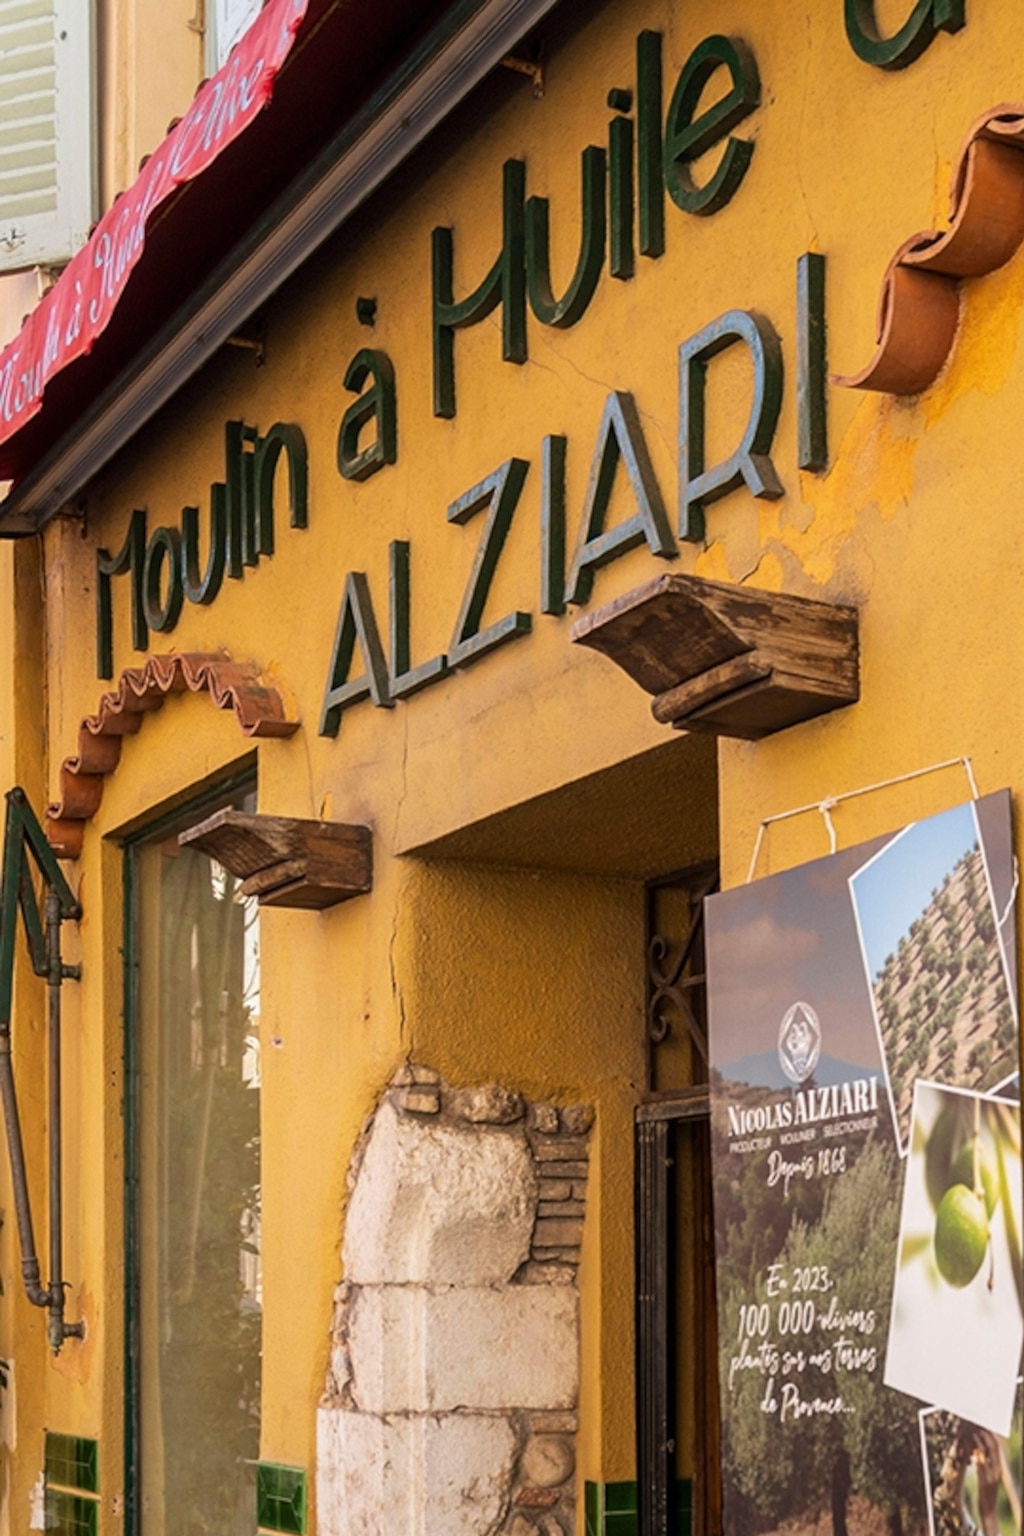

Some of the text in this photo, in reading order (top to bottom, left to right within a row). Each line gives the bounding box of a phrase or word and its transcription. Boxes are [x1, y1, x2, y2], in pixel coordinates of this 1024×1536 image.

[96, 29, 761, 680] Moulin à Huile
[318, 252, 827, 738] ALZIARI
[727, 1076, 879, 1137] NICOLAS ALZIARI
[767, 1146, 847, 1197] Depuis 1868
[738, 1296, 876, 1342] 100 000 oliviers
[760, 1377, 778, 1413] de
